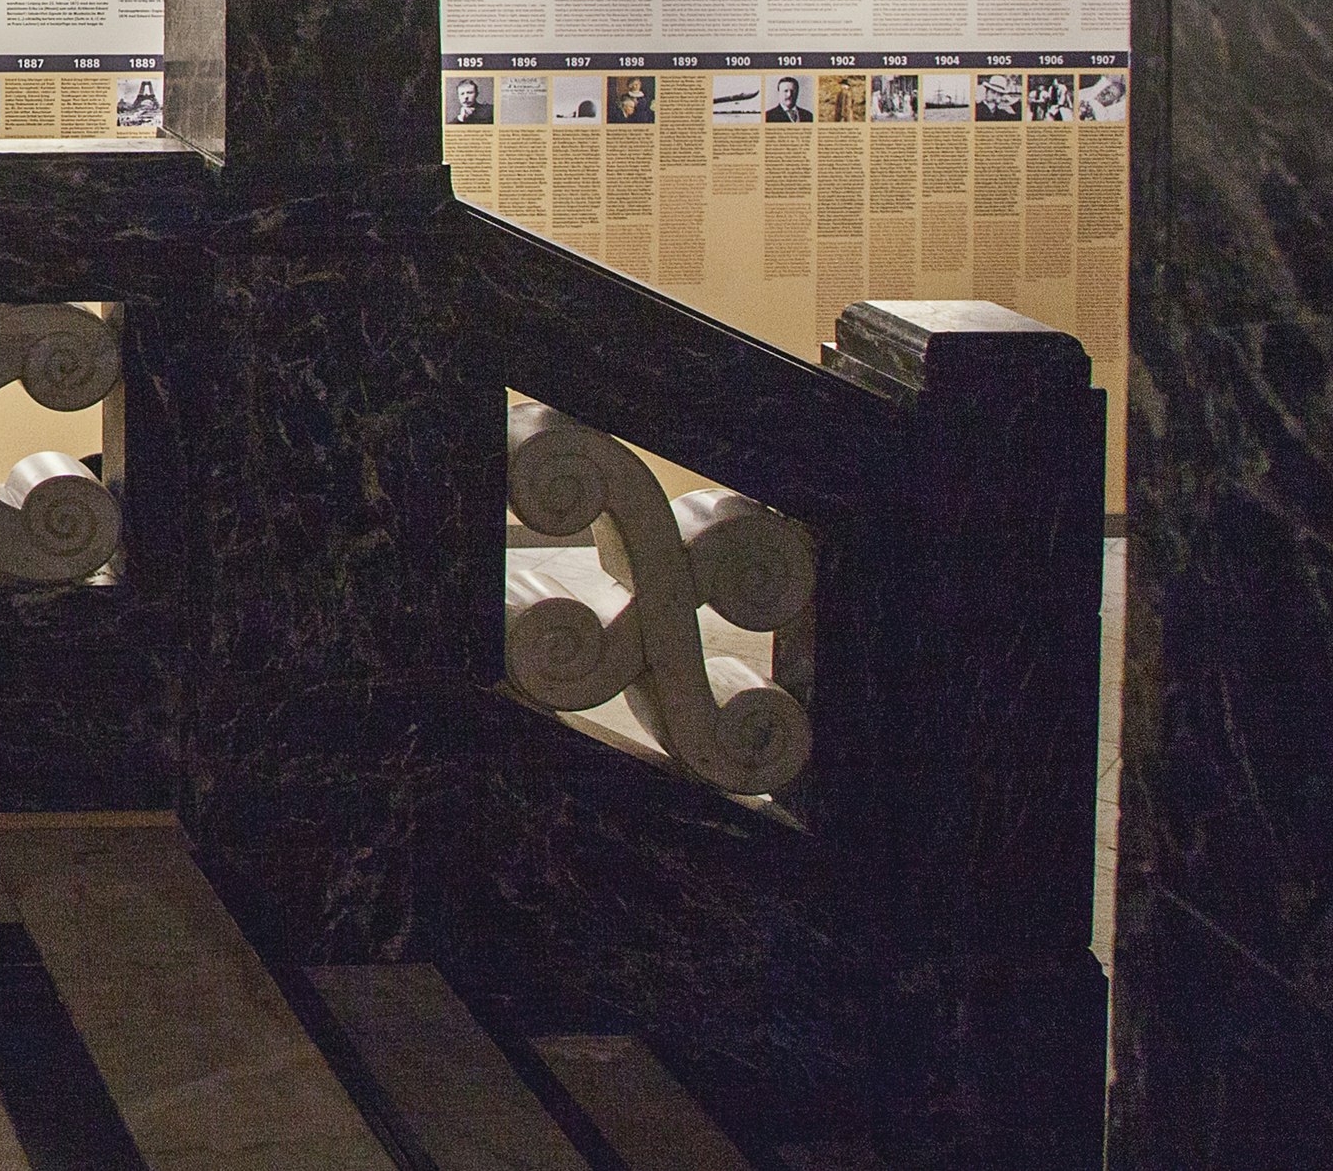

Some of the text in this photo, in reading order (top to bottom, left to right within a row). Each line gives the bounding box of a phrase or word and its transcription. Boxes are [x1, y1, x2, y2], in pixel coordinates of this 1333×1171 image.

[17, 58, 44, 69] 1887
[73, 58, 101, 69] 1888
[129, 57, 156, 68] 1889
[456, 55, 1116, 68] 1895 1896 1897 1898 1899 1900 1901 1902 1903 1904 1905 1906 1907
